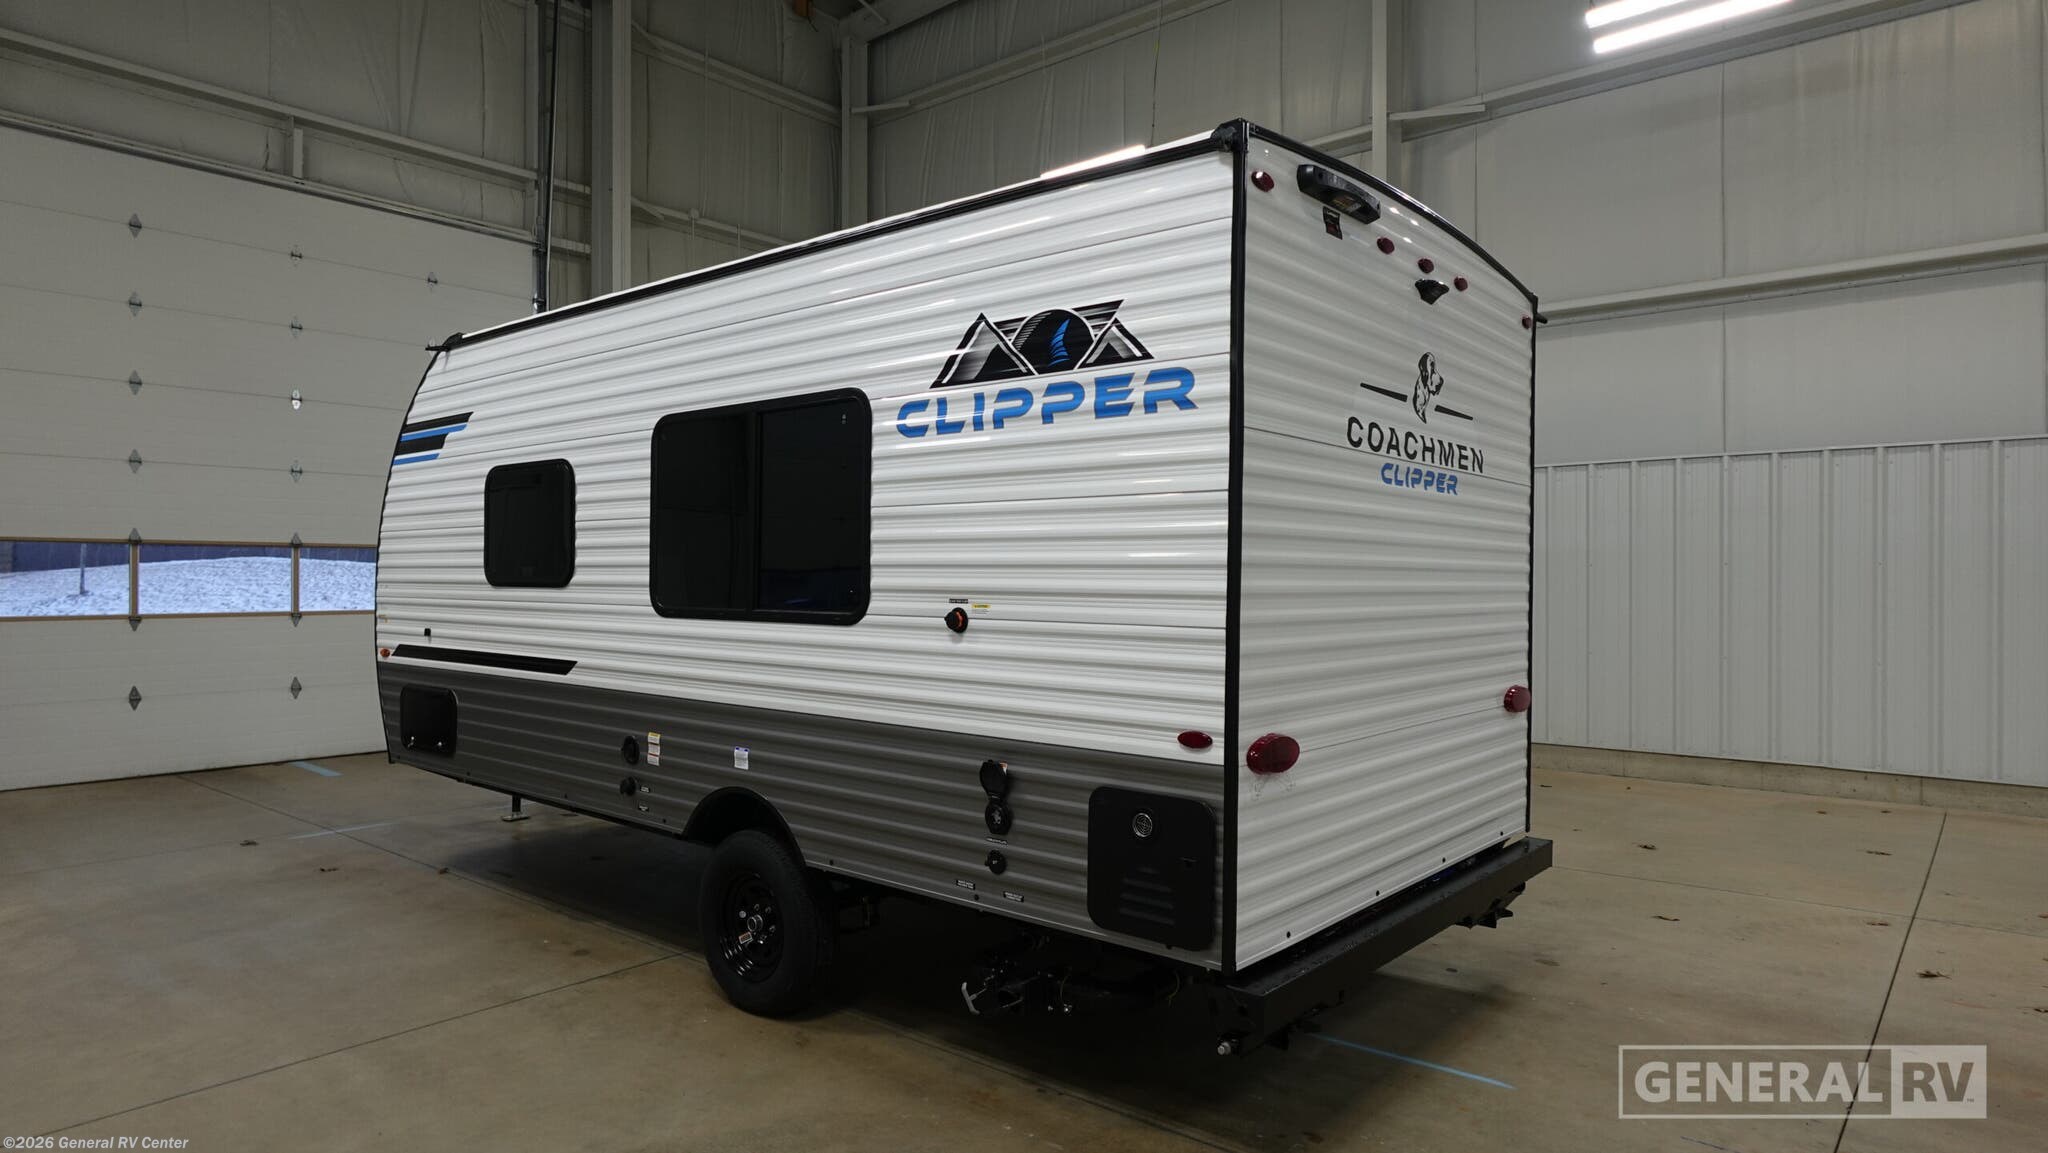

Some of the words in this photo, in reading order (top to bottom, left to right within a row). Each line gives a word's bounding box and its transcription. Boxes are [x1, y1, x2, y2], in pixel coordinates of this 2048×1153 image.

[896, 366, 1199, 438] CLIPPER
[1347, 416, 1485, 474] COACHMEN
[1380, 463, 1458, 495] CLIPPER
